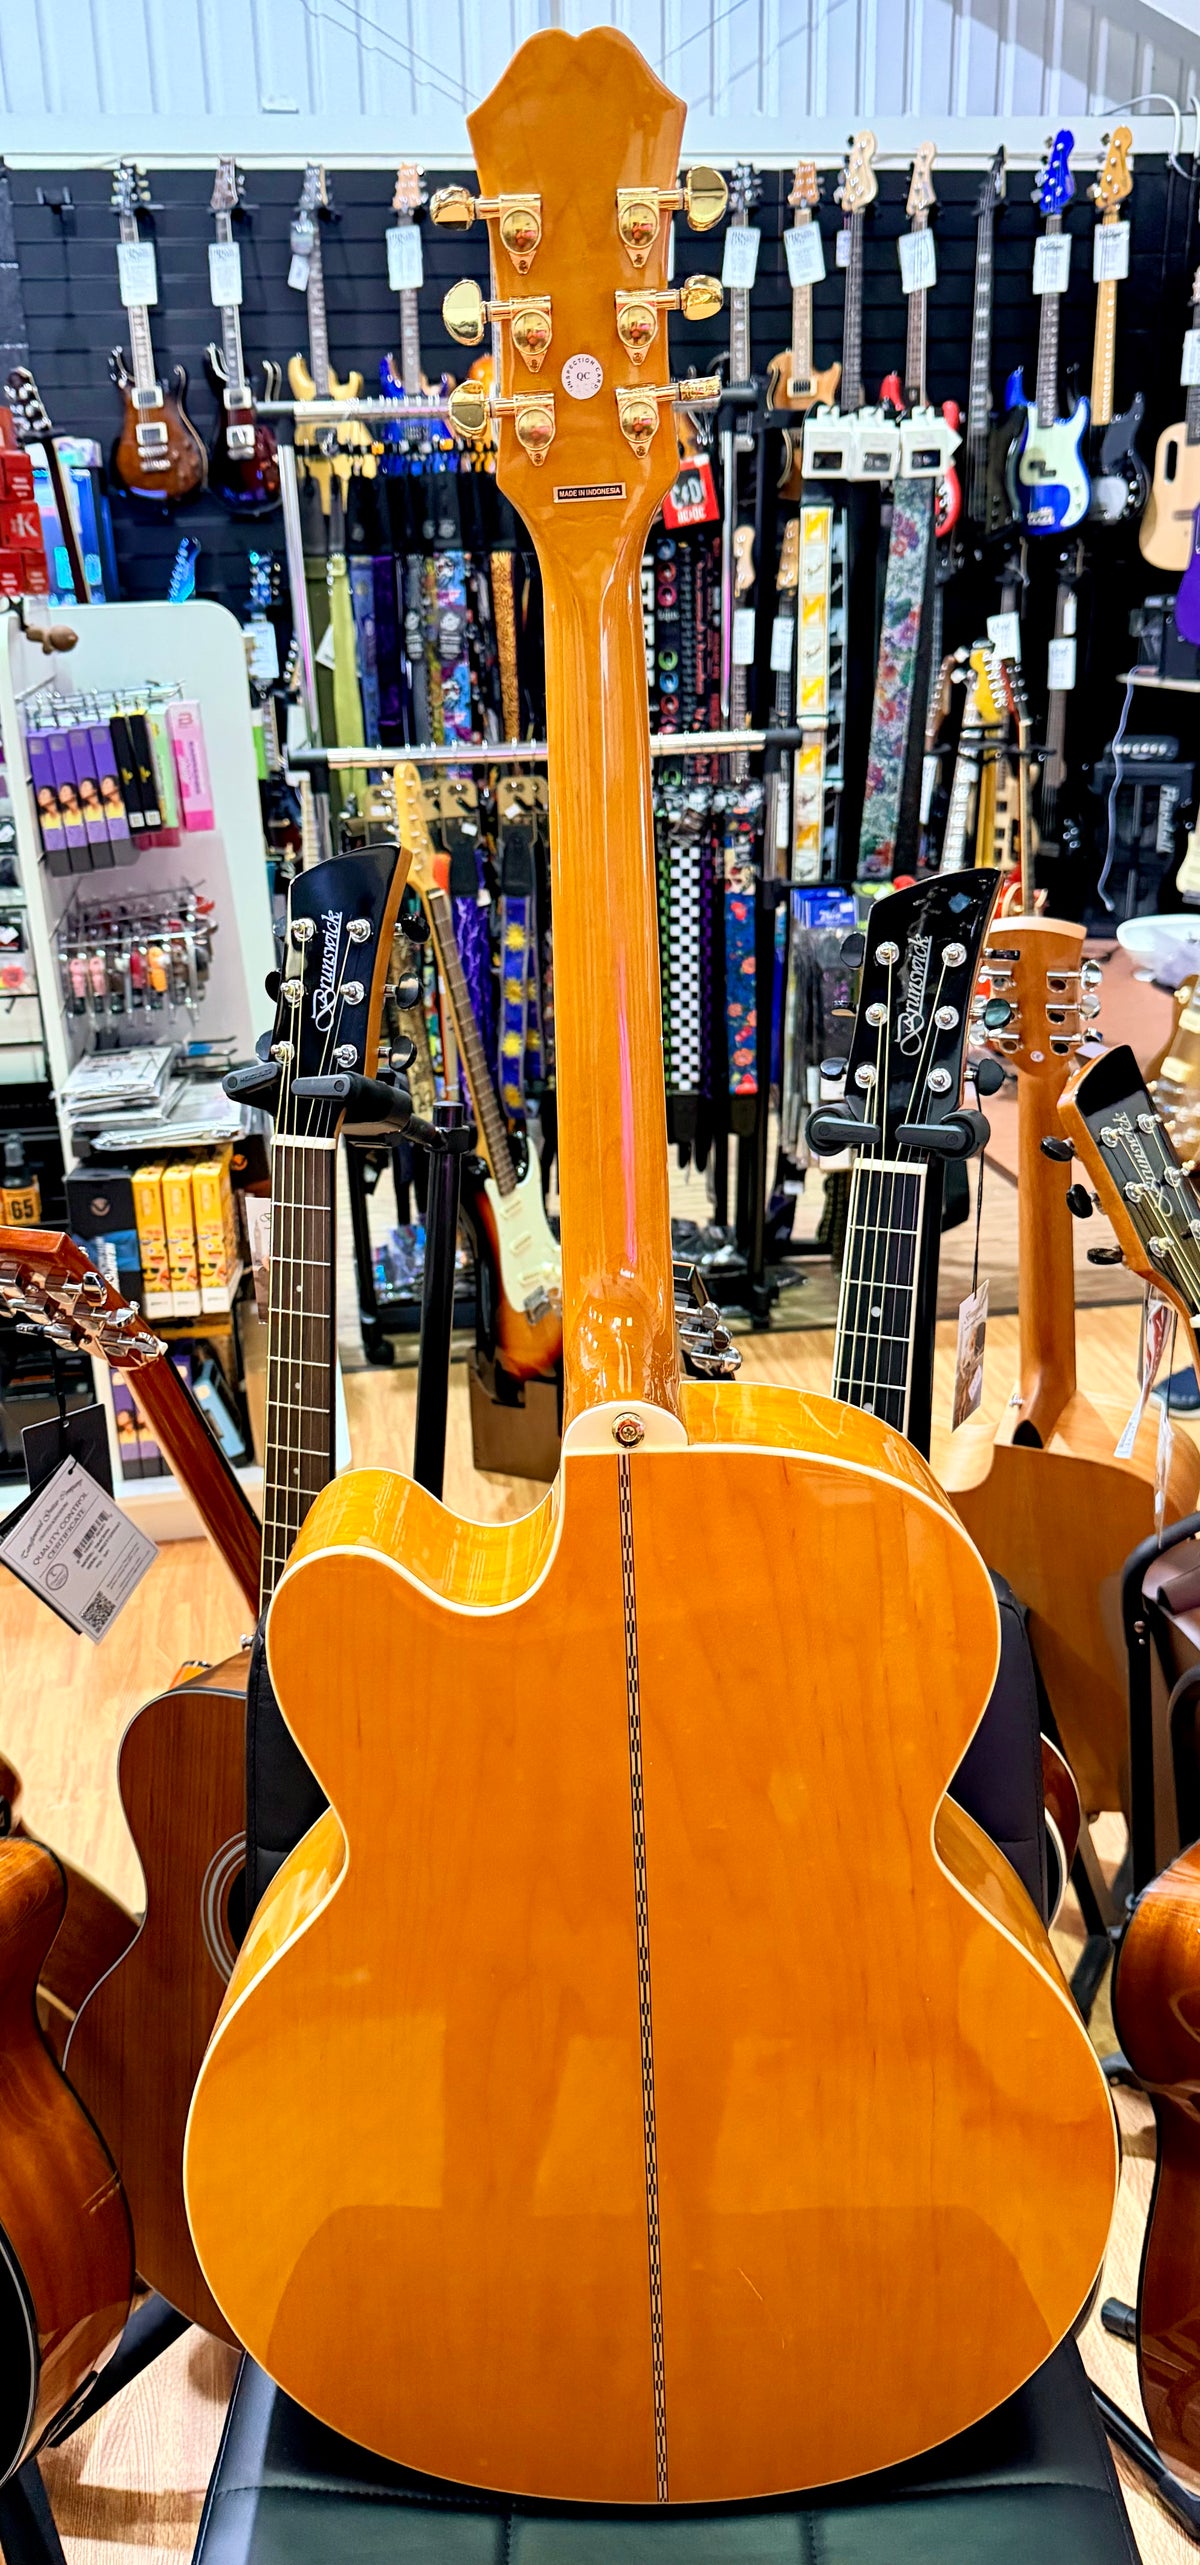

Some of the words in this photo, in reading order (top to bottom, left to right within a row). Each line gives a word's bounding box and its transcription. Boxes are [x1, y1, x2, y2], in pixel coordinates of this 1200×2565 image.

[565, 357, 595, 391] INSPECTION
[594, 367, 602, 389] CARD
[576, 371, 591, 382] QC
[559, 489, 578, 498] MADE
[577, 488, 586, 497] IN
[586, 487, 621, 496] INDONESIA
[311, 909, 343, 1032] Brunswick
[894, 933, 933, 1056] Brunswick
[11, 1198, 34, 1220] 65
[31, 1528, 60, 1565] QUALITY
[58, 1491, 88, 1529] CONTROL
[46, 1508, 85, 1559] CERTIFICATE
